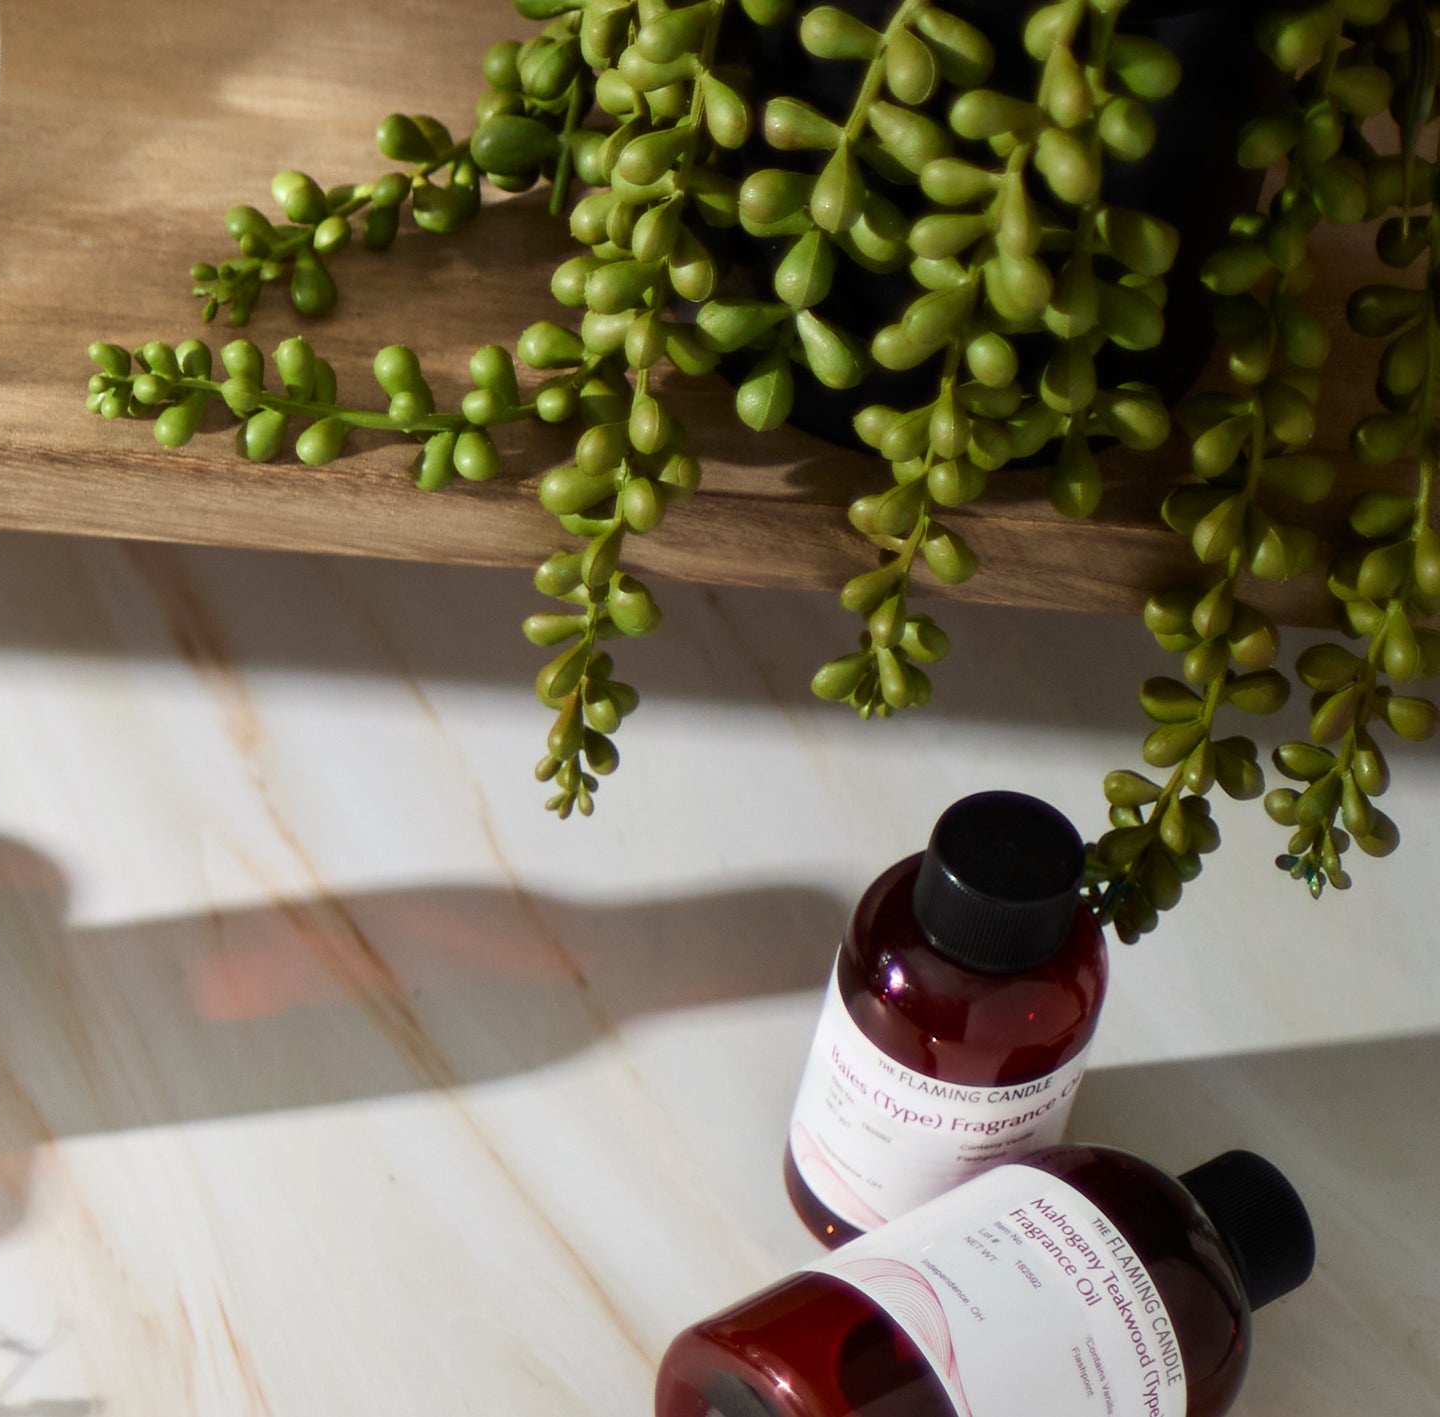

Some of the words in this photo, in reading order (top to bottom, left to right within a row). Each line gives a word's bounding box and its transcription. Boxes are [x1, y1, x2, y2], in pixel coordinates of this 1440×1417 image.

[878, 1058, 897, 1076] THE
[898, 1071, 984, 1105] FLAMING
[986, 1075, 1054, 1105] CANDLE
[873, 1088, 943, 1130] (Type)
[950, 1096, 1057, 1137] Fragrance
[963, 1235, 985, 1250] NET
[1009, 1207, 1078, 1277] Fragrance
[1075, 1276, 1103, 1308] Oil
[1030, 1198, 1105, 1272] Mahogany
[1101, 1270, 1157, 1369] Teakwood
[1091, 1217, 1112, 1237] THE
[1105, 1235, 1162, 1315] FLAMING
[1151, 1315, 1183, 1387] CANDLE
[970, 1306, 987, 1323] OH
